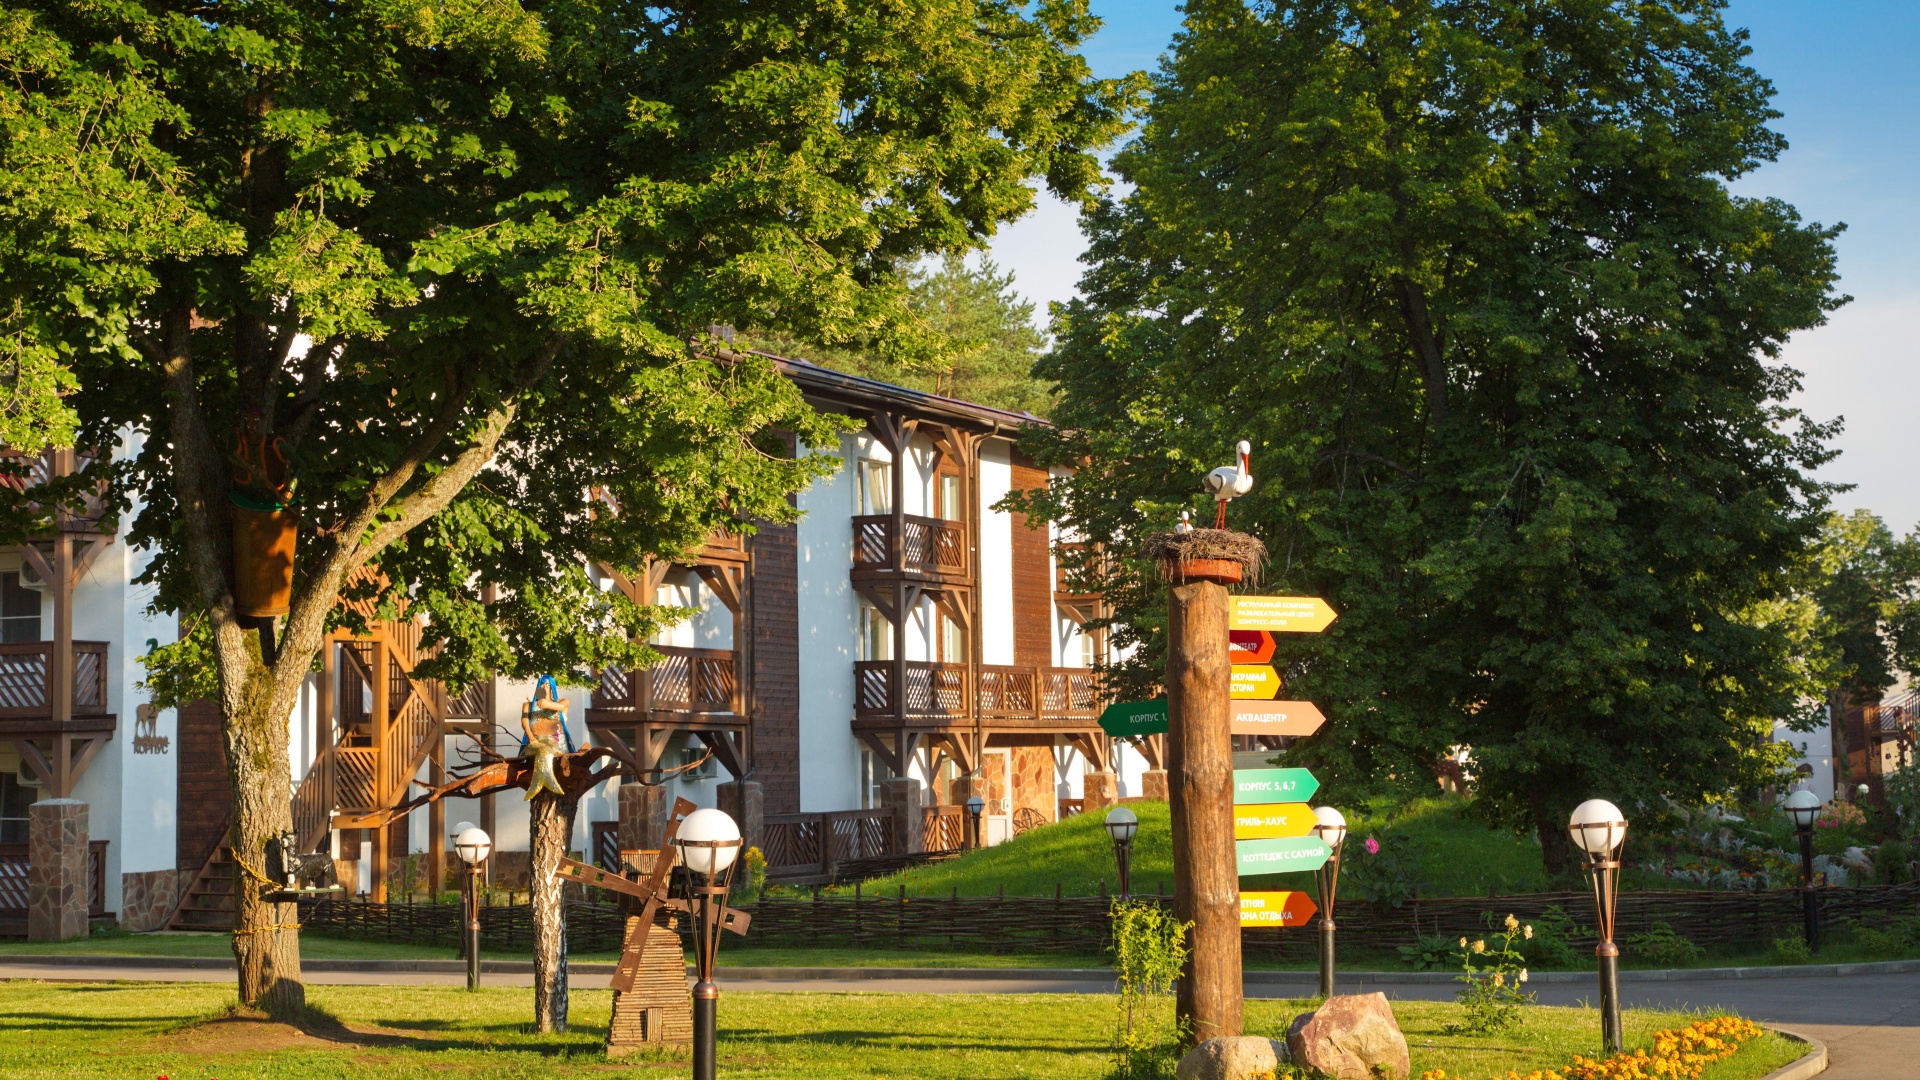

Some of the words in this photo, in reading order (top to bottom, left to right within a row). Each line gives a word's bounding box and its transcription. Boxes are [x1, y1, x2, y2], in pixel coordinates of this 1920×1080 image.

[1230, 671, 1267, 682] АНОРАМНЫЙ
[1230, 683, 1255, 692] ЕСТОРАН
[1129, 713, 1159, 724] КОРПУС
[1236, 713, 1287, 723] АКВАЦЕНТР
[133, 743, 169, 755] КОРПУС
[1238, 782, 1272, 792] КОРПУС
[1236, 816, 1288, 827] ГРИЛЬ-ХАУС
[1242, 852, 1283, 863] КОТТЕДЖ
[1284, 851, 1290, 859] С
[1290, 846, 1325, 859] САУНОЙ
[1240, 899, 1265, 909] ЕТНЯЯ
[1239, 911, 1258, 920] ОНА
[1258, 911, 1293, 922] ОТДЫХА
